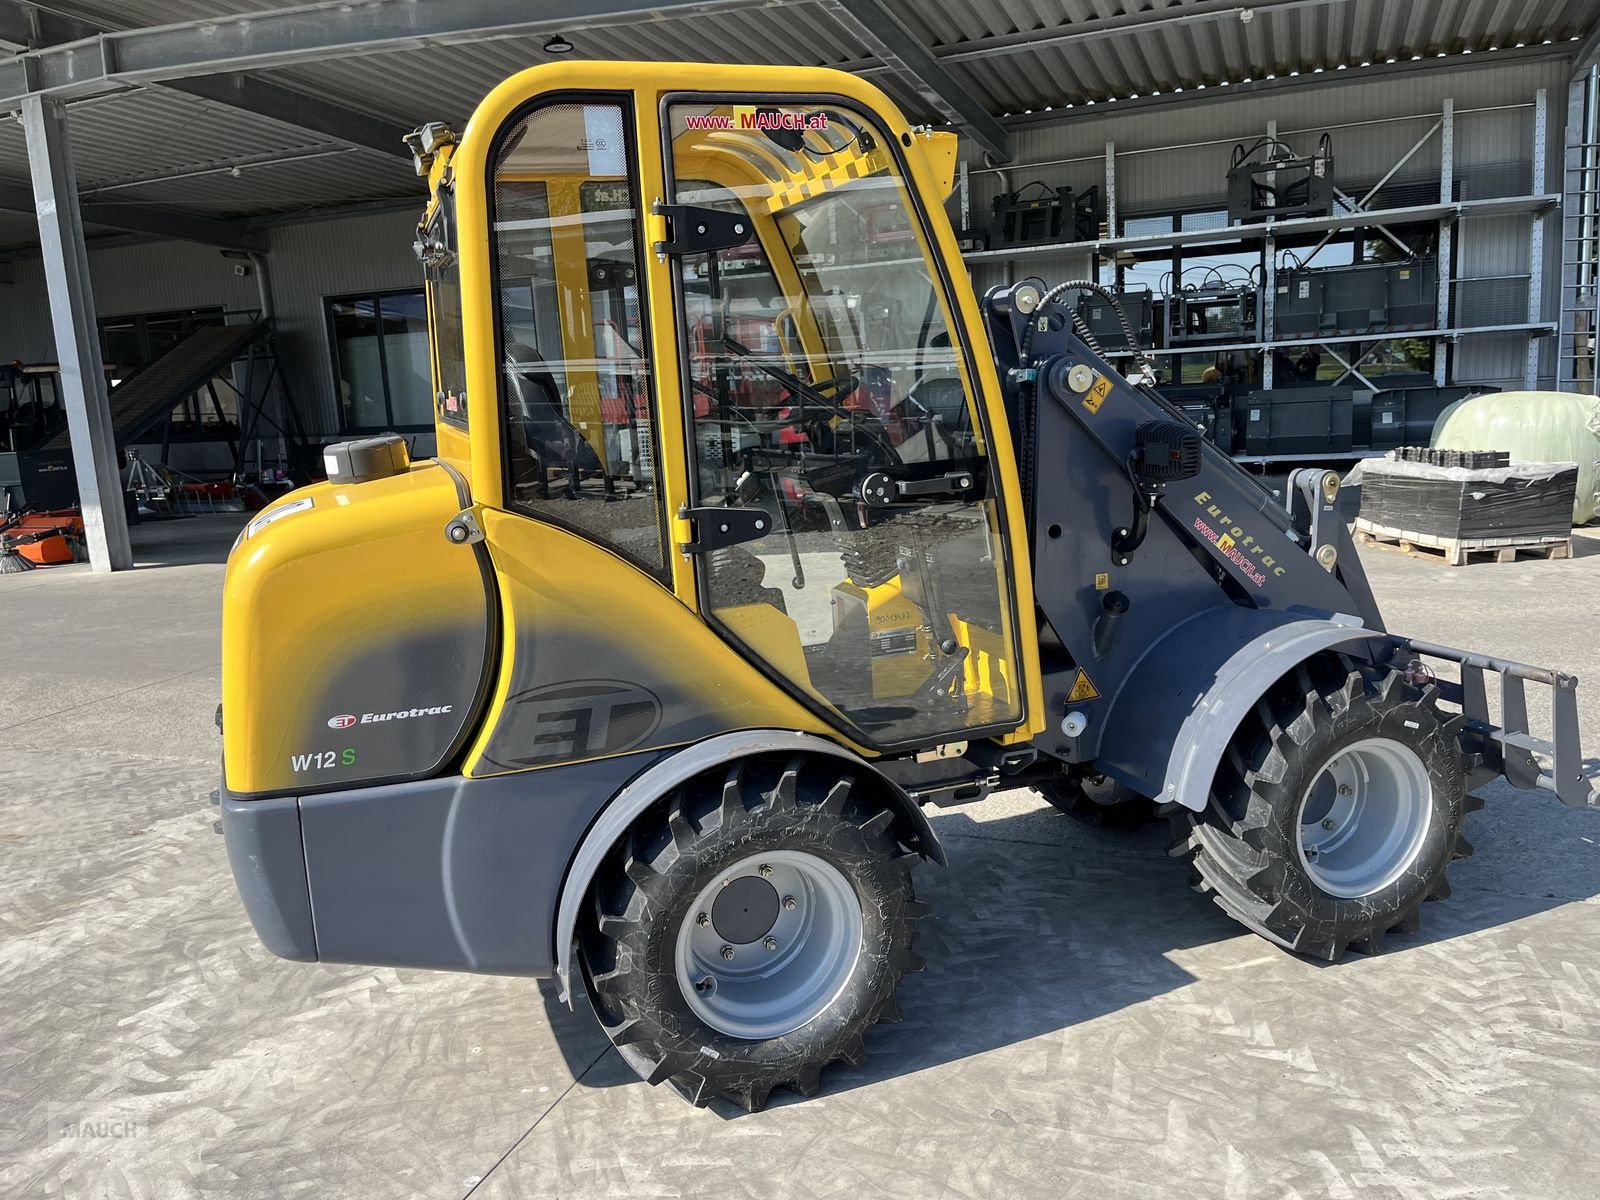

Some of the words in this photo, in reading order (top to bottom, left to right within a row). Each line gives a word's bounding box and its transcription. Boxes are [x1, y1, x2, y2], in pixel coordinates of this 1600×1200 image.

[1194, 491, 1286, 576] Eurotrac
[360, 704, 453, 724] Eurotrac
[515, 688, 652, 762] ET
[291, 751, 336, 772] W12
[341, 748, 356, 766] S
